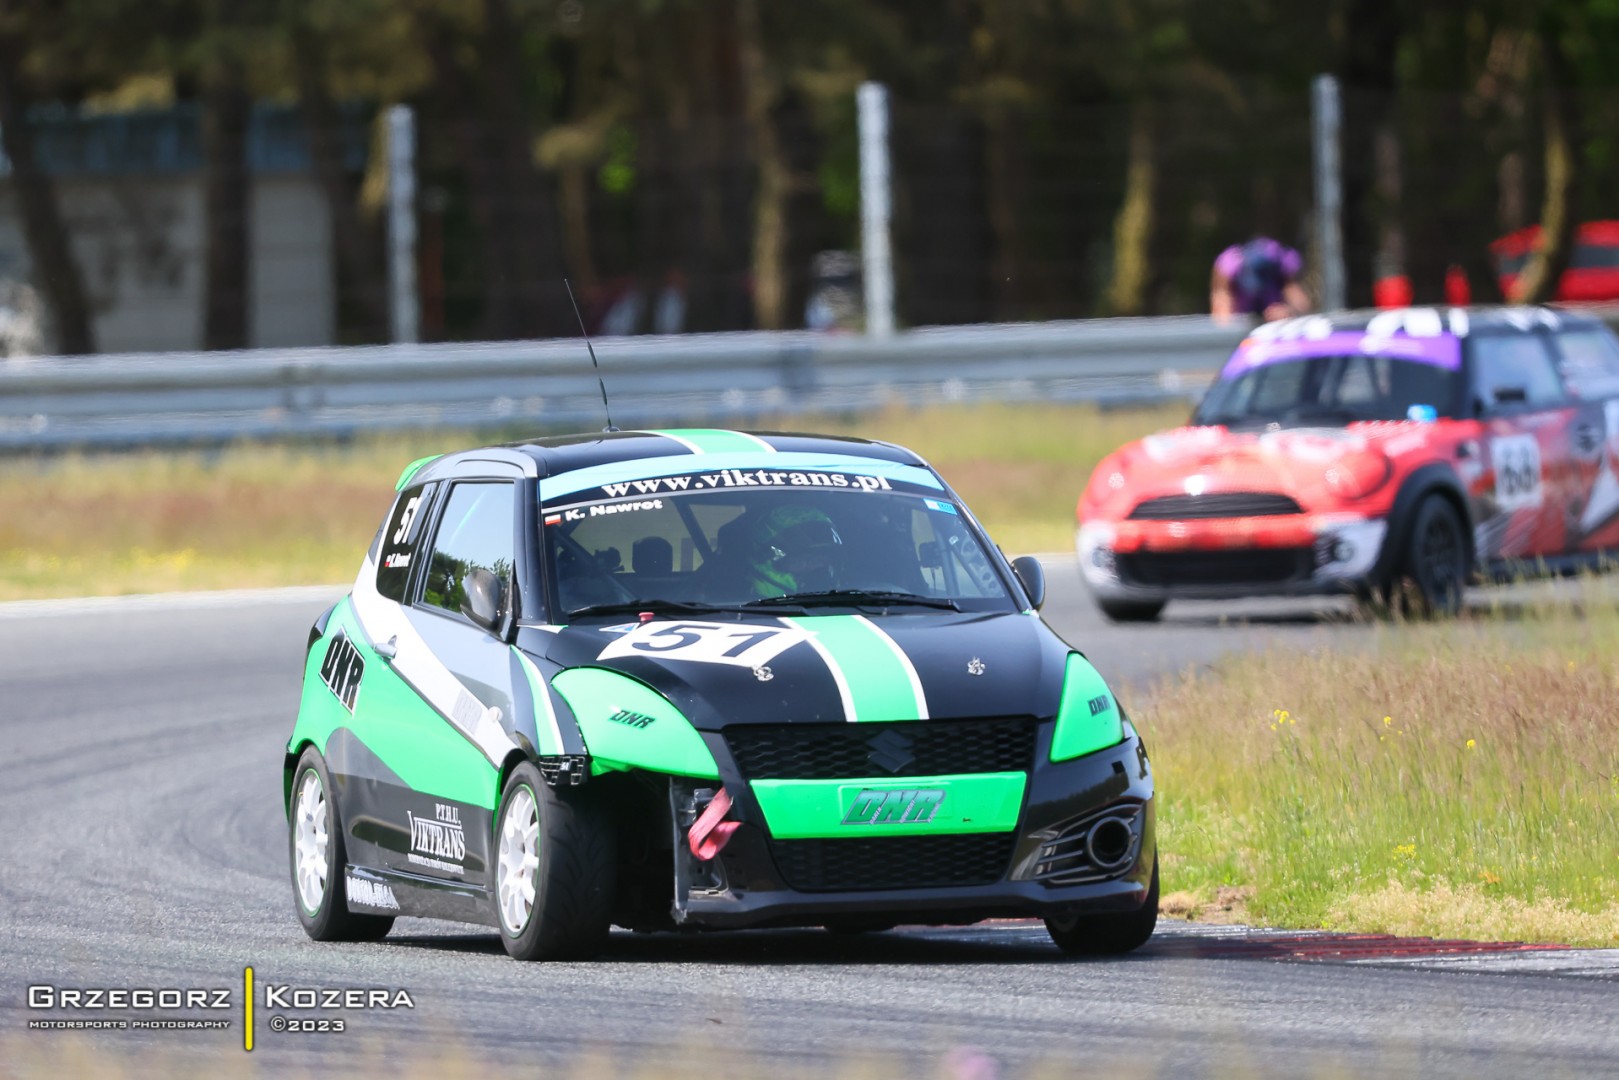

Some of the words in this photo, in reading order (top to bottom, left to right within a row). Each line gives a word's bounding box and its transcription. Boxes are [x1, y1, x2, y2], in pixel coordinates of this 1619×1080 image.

[601, 469, 893, 498] www.viktrans.pl
[565, 511, 586, 521] K.
[589, 499, 663, 517] Nawrot
[632, 624, 783, 657] 51
[318, 624, 366, 718] DNR
[610, 709, 656, 729] DNR
[840, 789, 947, 825] DNR
[407, 810, 466, 861] VIKTRANS
